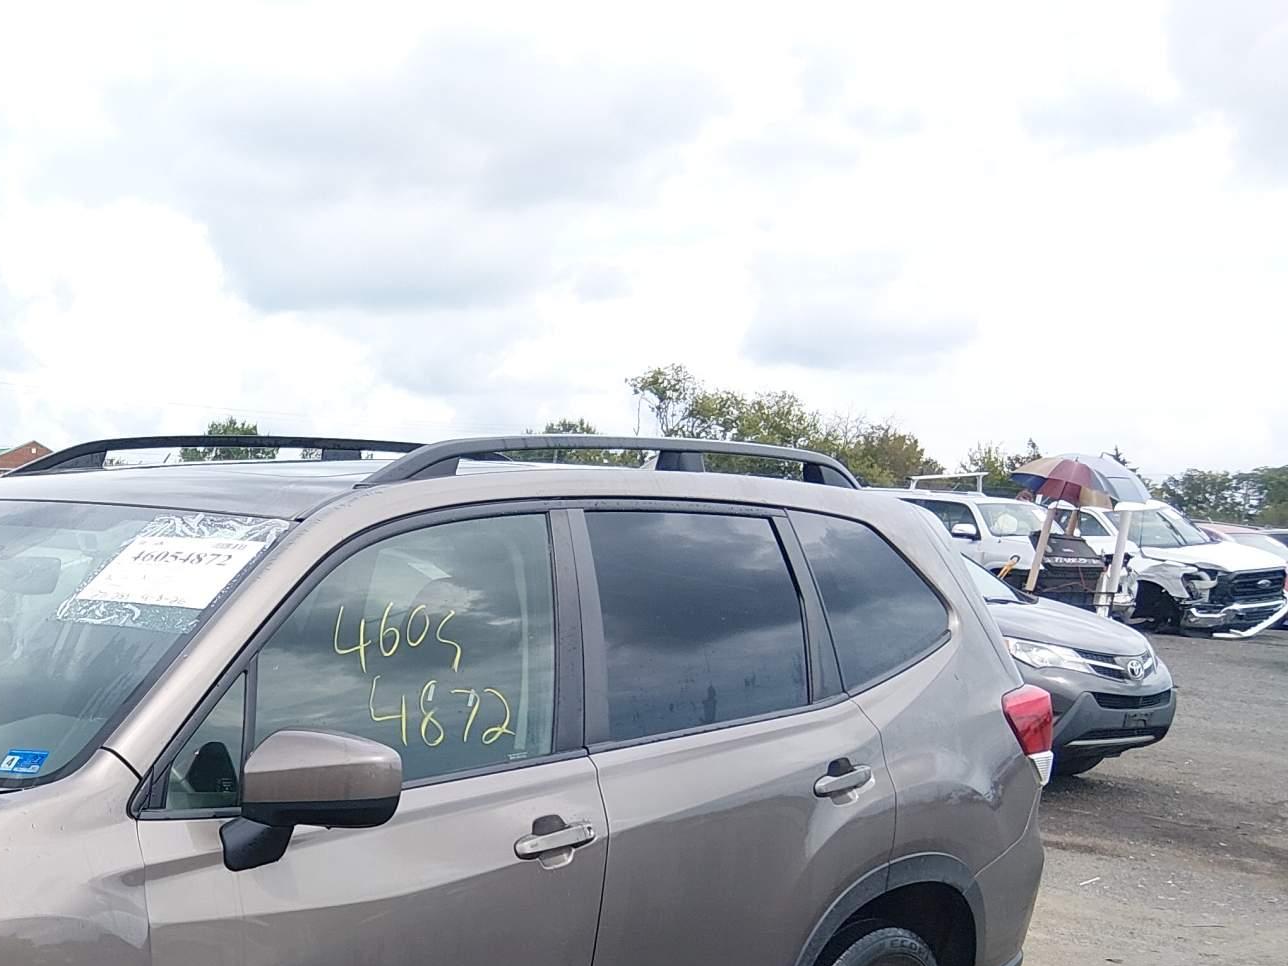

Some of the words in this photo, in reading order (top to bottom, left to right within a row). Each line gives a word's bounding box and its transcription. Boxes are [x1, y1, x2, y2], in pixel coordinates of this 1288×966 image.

[132, 549, 233, 567] 46054872
[334, 602, 462, 673] 4605
[369, 674, 516, 747] 4872
